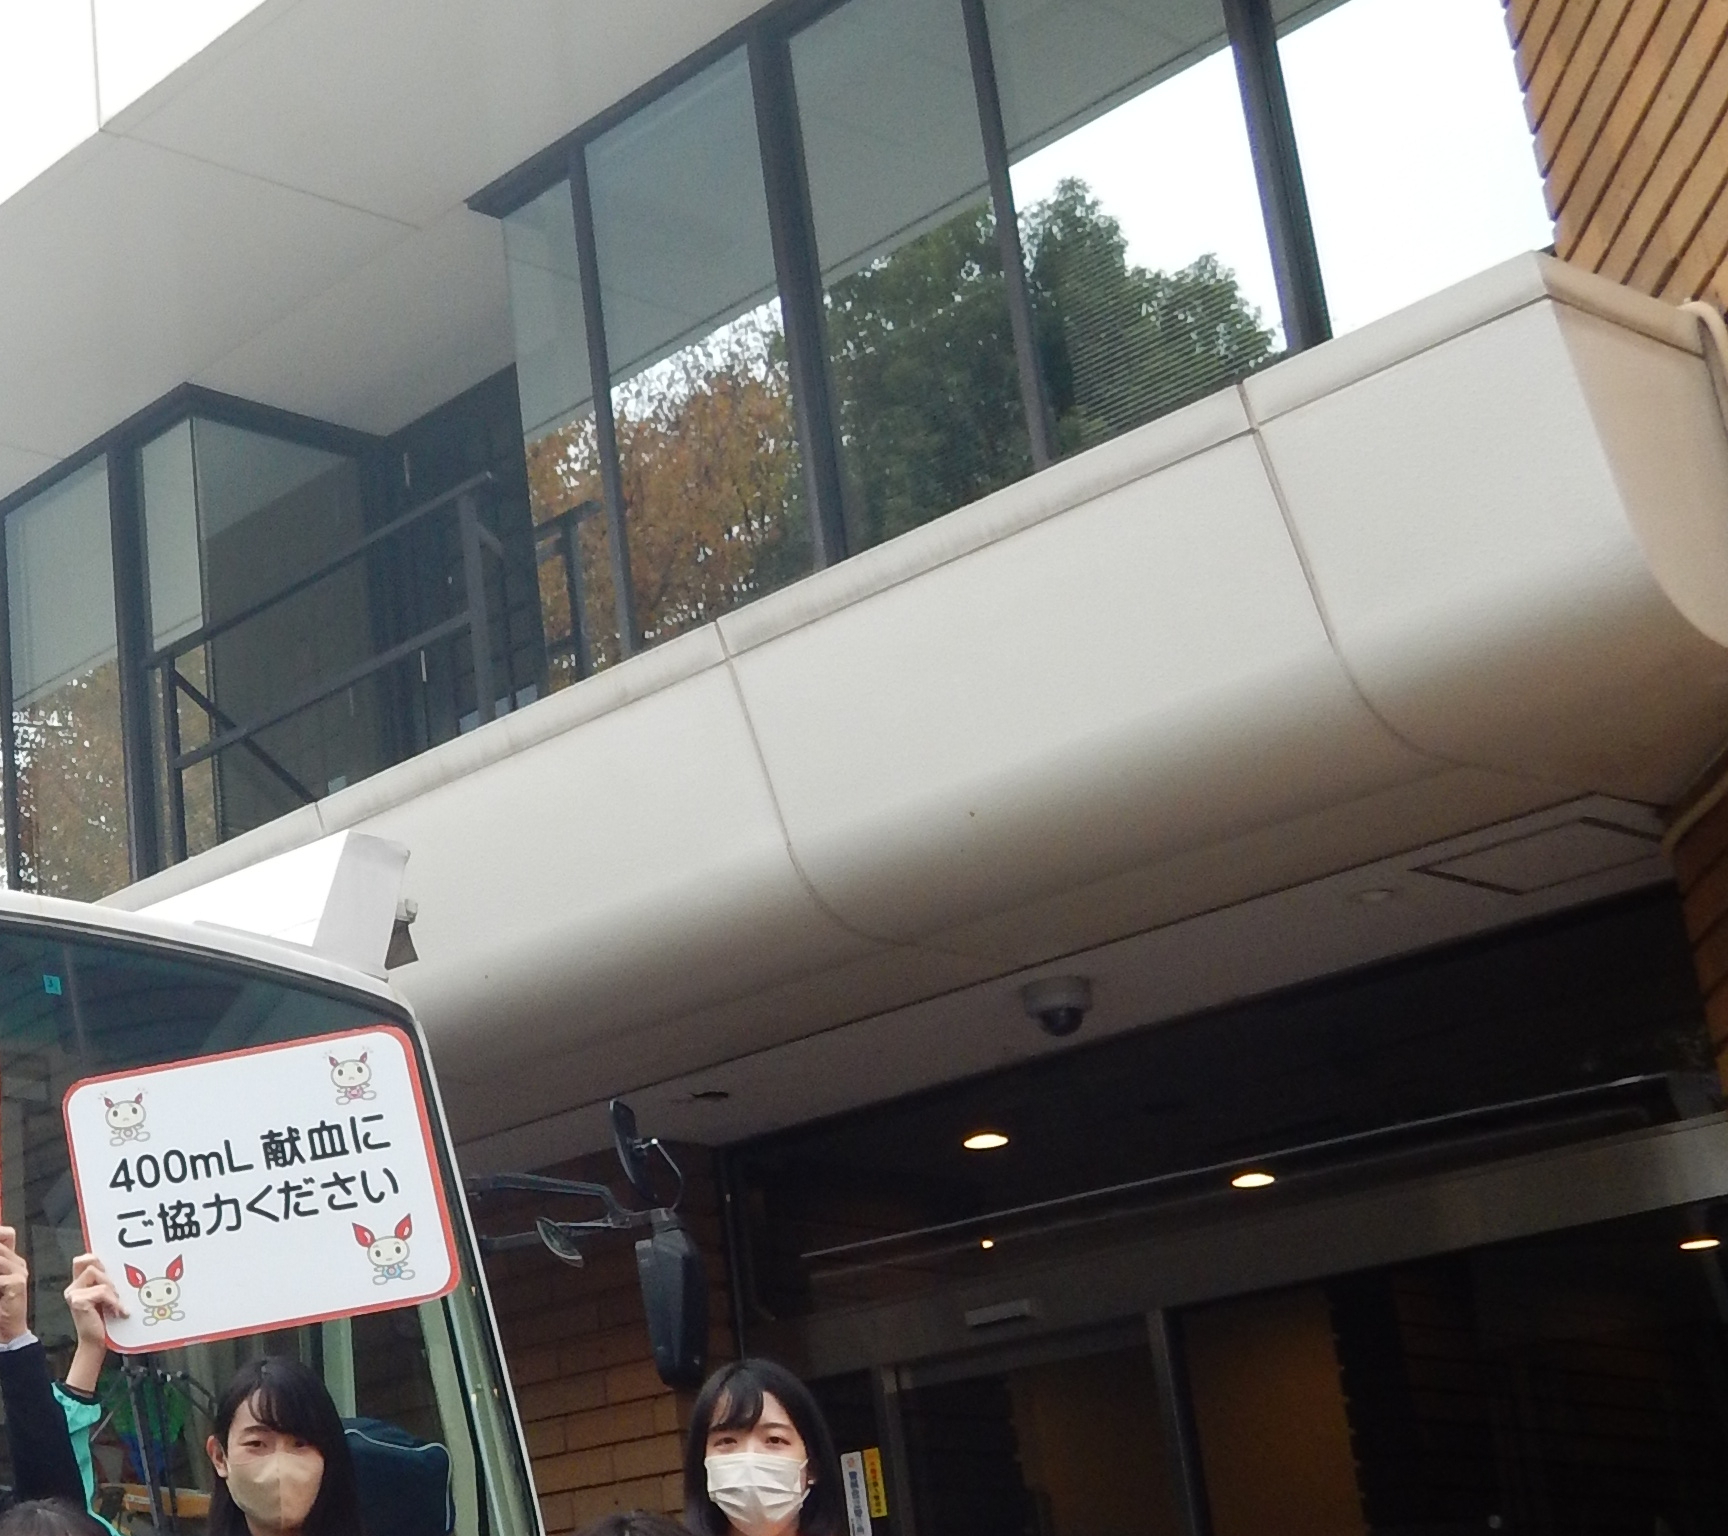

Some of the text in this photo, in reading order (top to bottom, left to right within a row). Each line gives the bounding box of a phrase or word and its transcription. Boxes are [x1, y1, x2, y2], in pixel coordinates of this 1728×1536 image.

[109, 1114, 391, 1192] 400mL 献血に
[117, 1167, 399, 1248] ご協力ください
